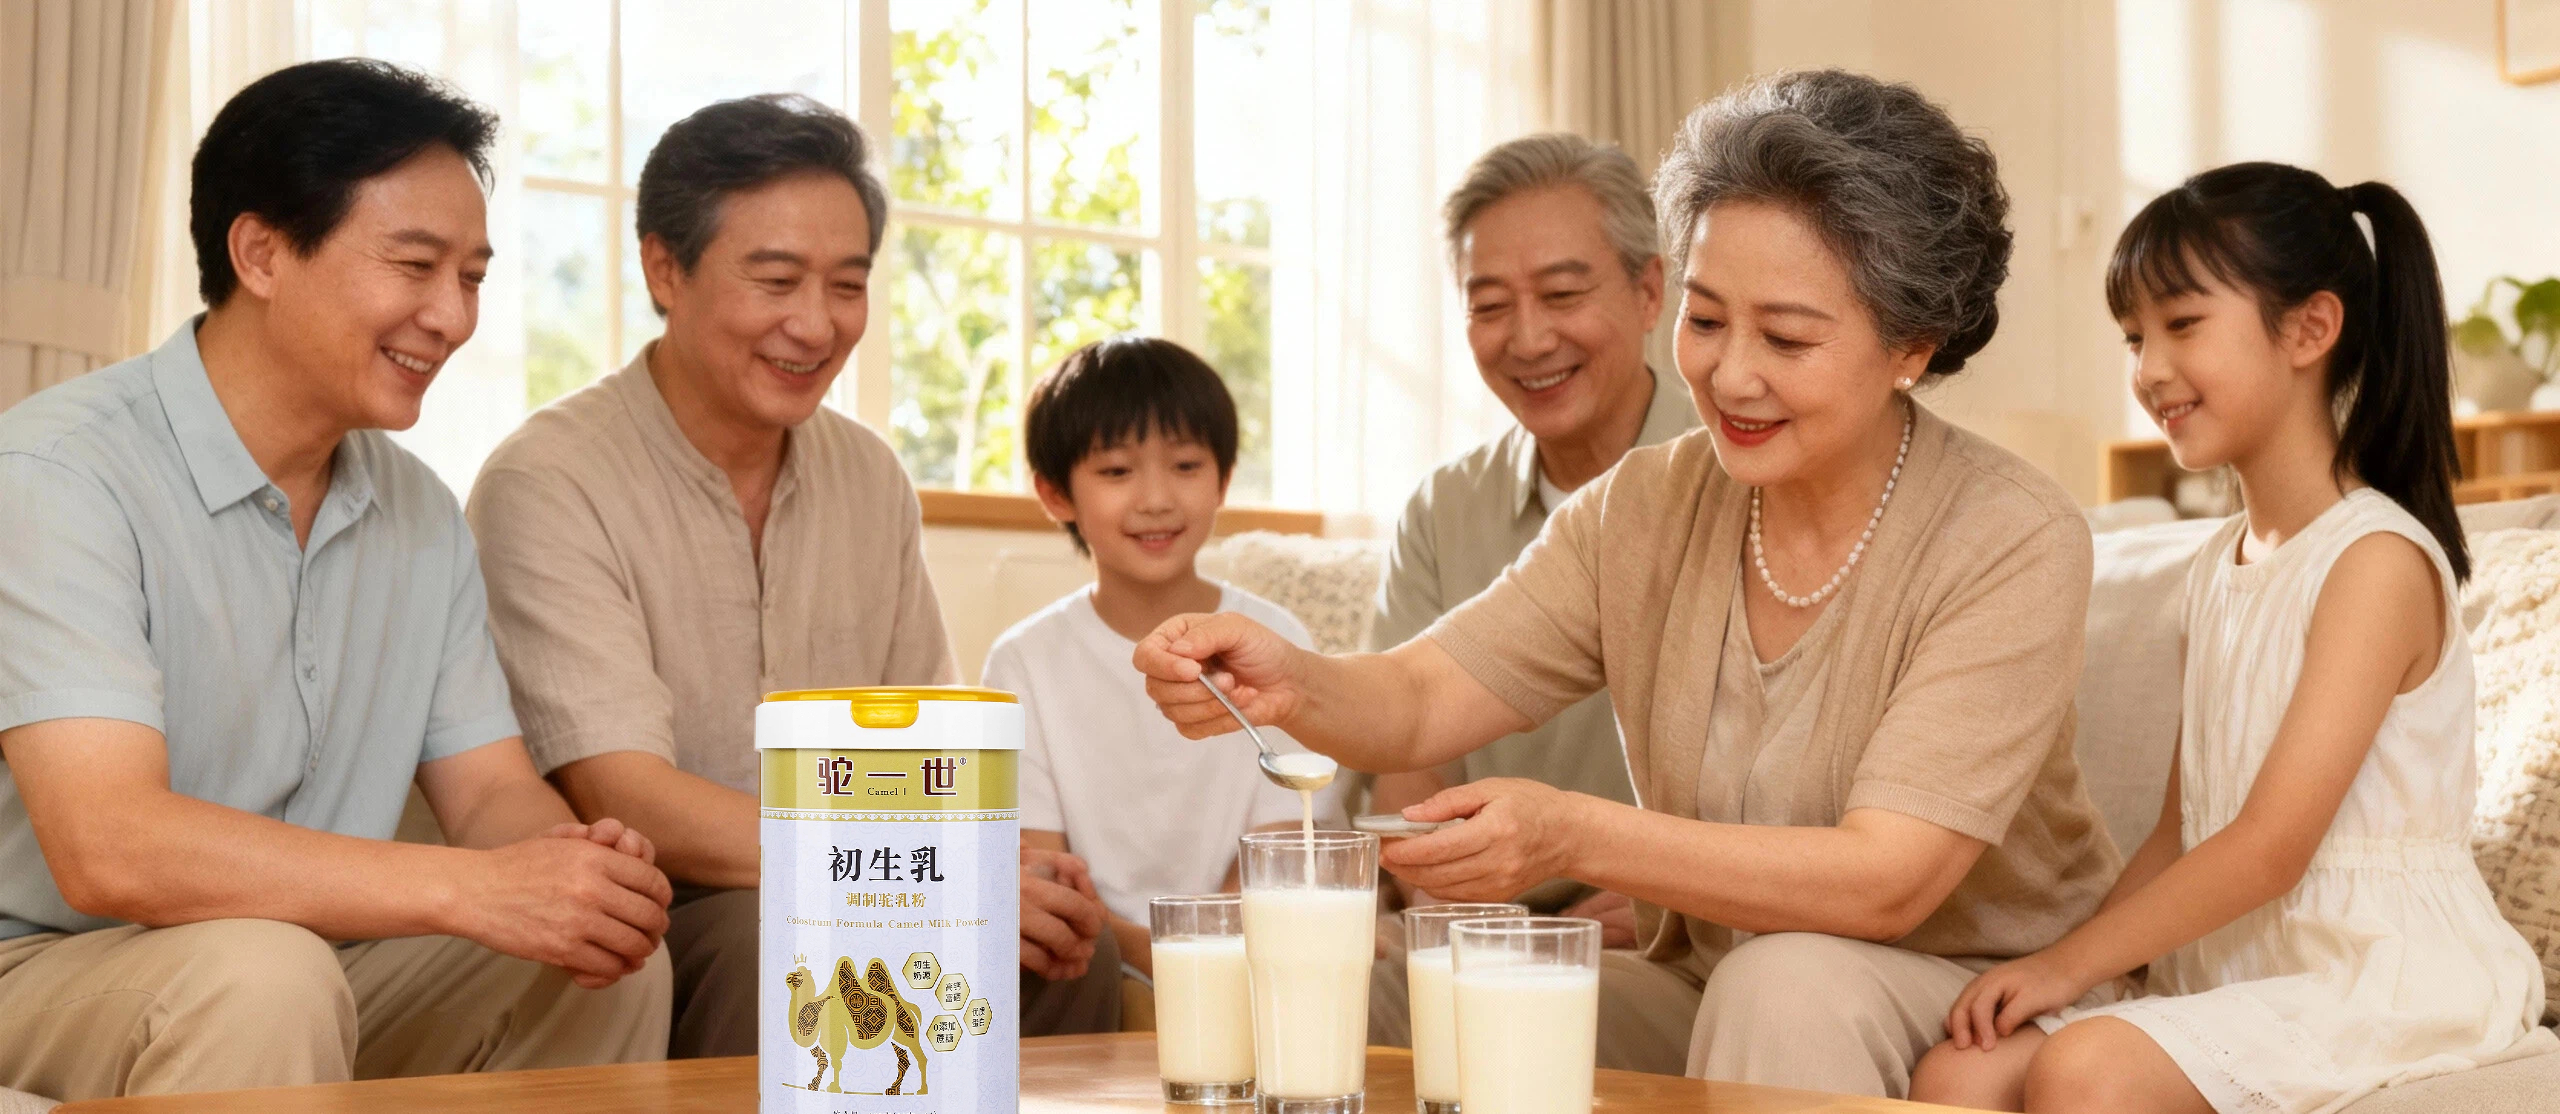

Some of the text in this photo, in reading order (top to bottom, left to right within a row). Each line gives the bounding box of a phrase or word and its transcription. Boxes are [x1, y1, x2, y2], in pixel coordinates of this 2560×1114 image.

[817, 756, 957, 796] 驼一世
[867, 788, 898, 796] Camel
[828, 845, 945, 883] 初生乳
[846, 892, 927, 908] 调制驼乳粉
[786, 915, 989, 929] Colostrum Formula Camel Milk Powder
[913, 960, 931, 970] 初生
[913, 971, 931, 980] 奶源
